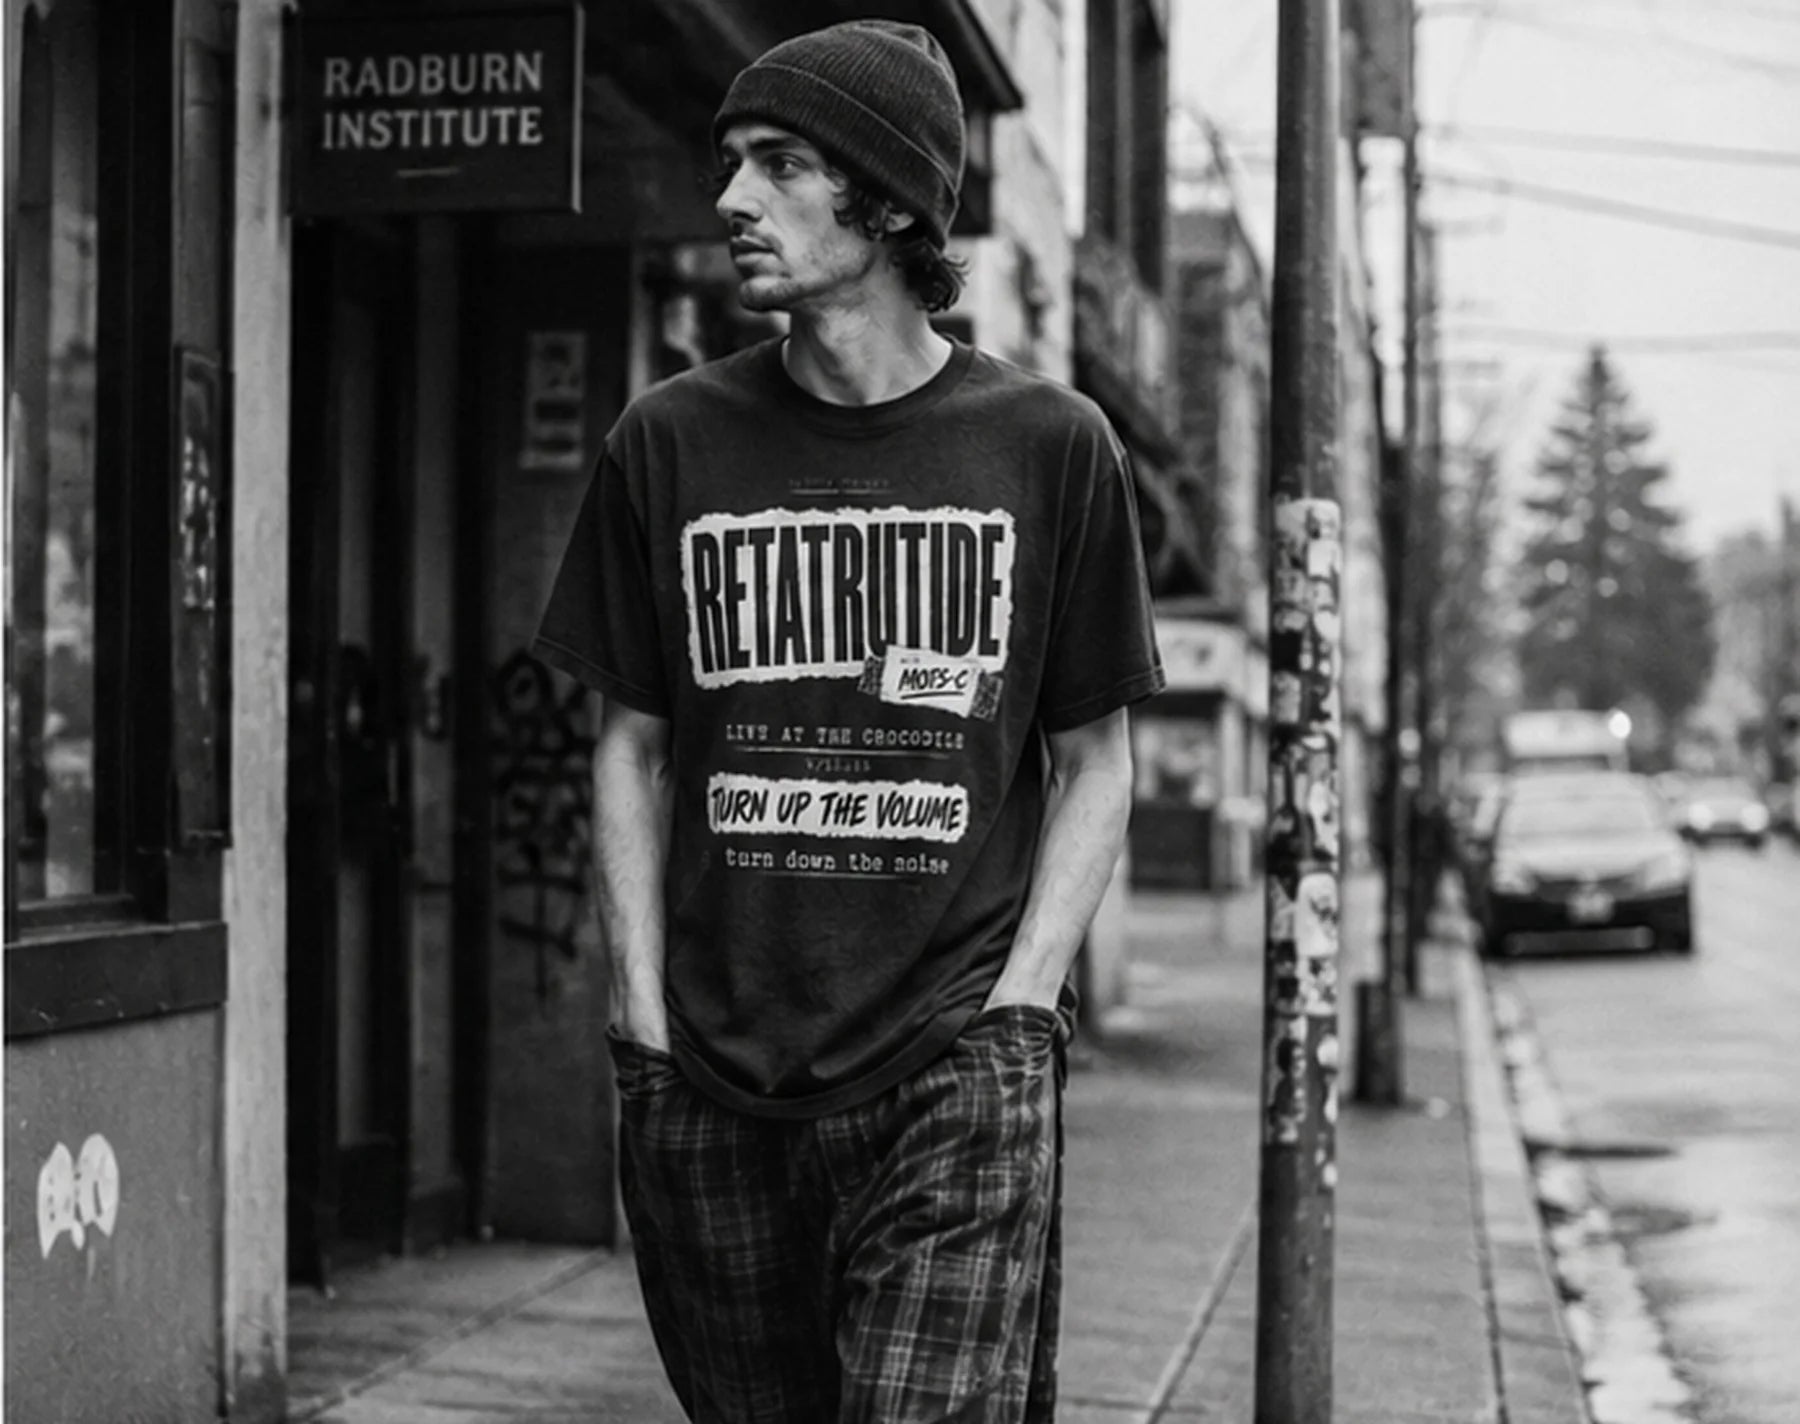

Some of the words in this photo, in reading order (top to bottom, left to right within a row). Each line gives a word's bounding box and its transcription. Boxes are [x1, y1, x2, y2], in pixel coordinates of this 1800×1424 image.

[324, 51, 543, 97] RADBURN
[322, 106, 543, 150] INSTITUTE
[691, 521, 1005, 674] RETATRUTIDE
[781, 726, 804, 743] AT
[711, 786, 769, 825] TURN
[776, 791, 812, 826] UP
[820, 791, 869, 828] THE
[876, 790, 963, 832] VOLUME
[726, 848, 774, 868] turn
[785, 849, 836, 871] down
